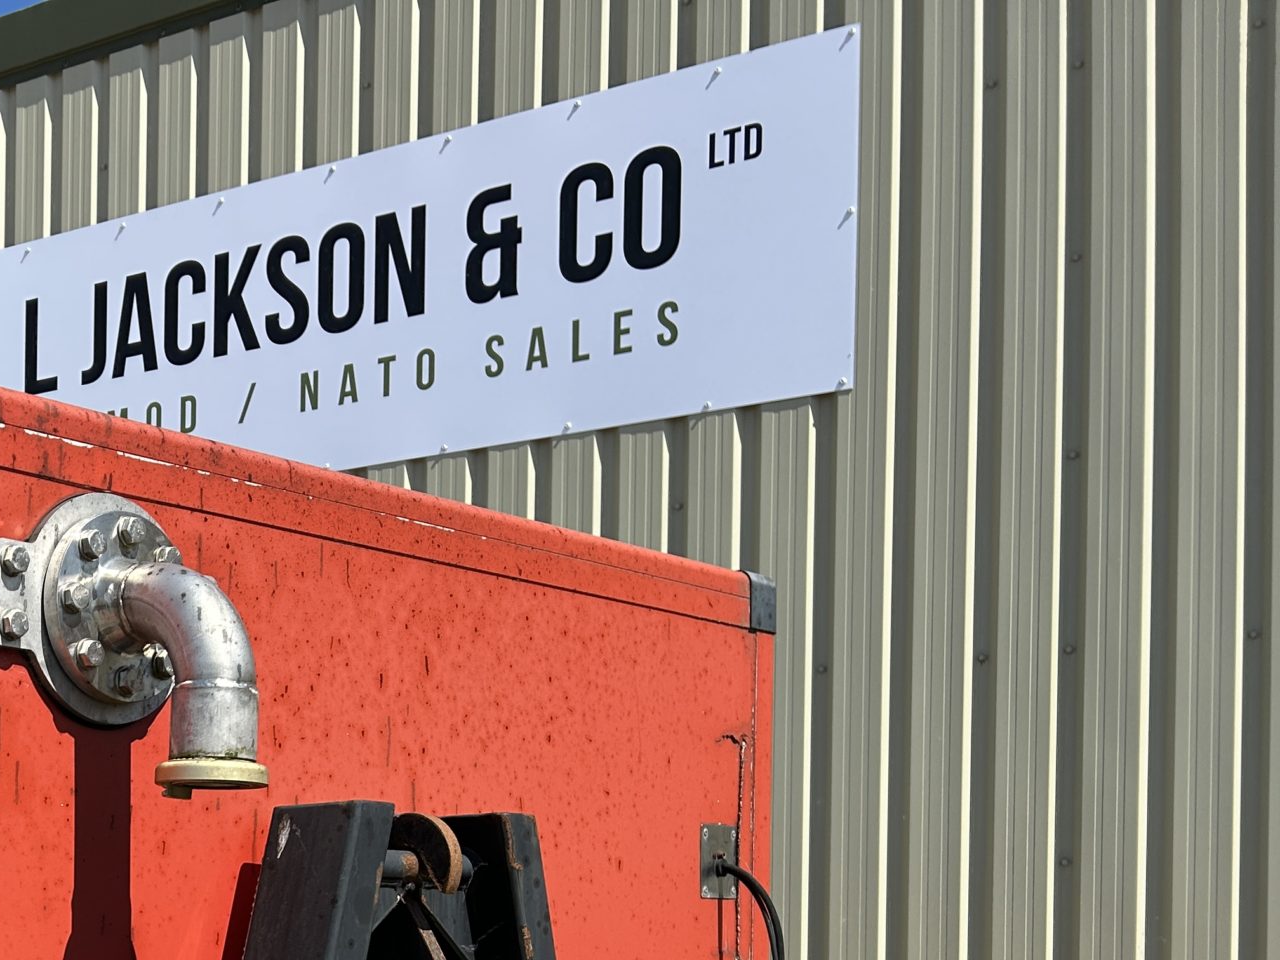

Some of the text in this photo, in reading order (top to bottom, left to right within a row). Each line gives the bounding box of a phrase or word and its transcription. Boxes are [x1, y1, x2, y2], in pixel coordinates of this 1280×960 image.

[24, 122, 763, 395] L JACKSON & CO LTD
[107, 395, 197, 433] OD
[299, 348, 437, 413] NATO
[484, 301, 679, 378] SALES
